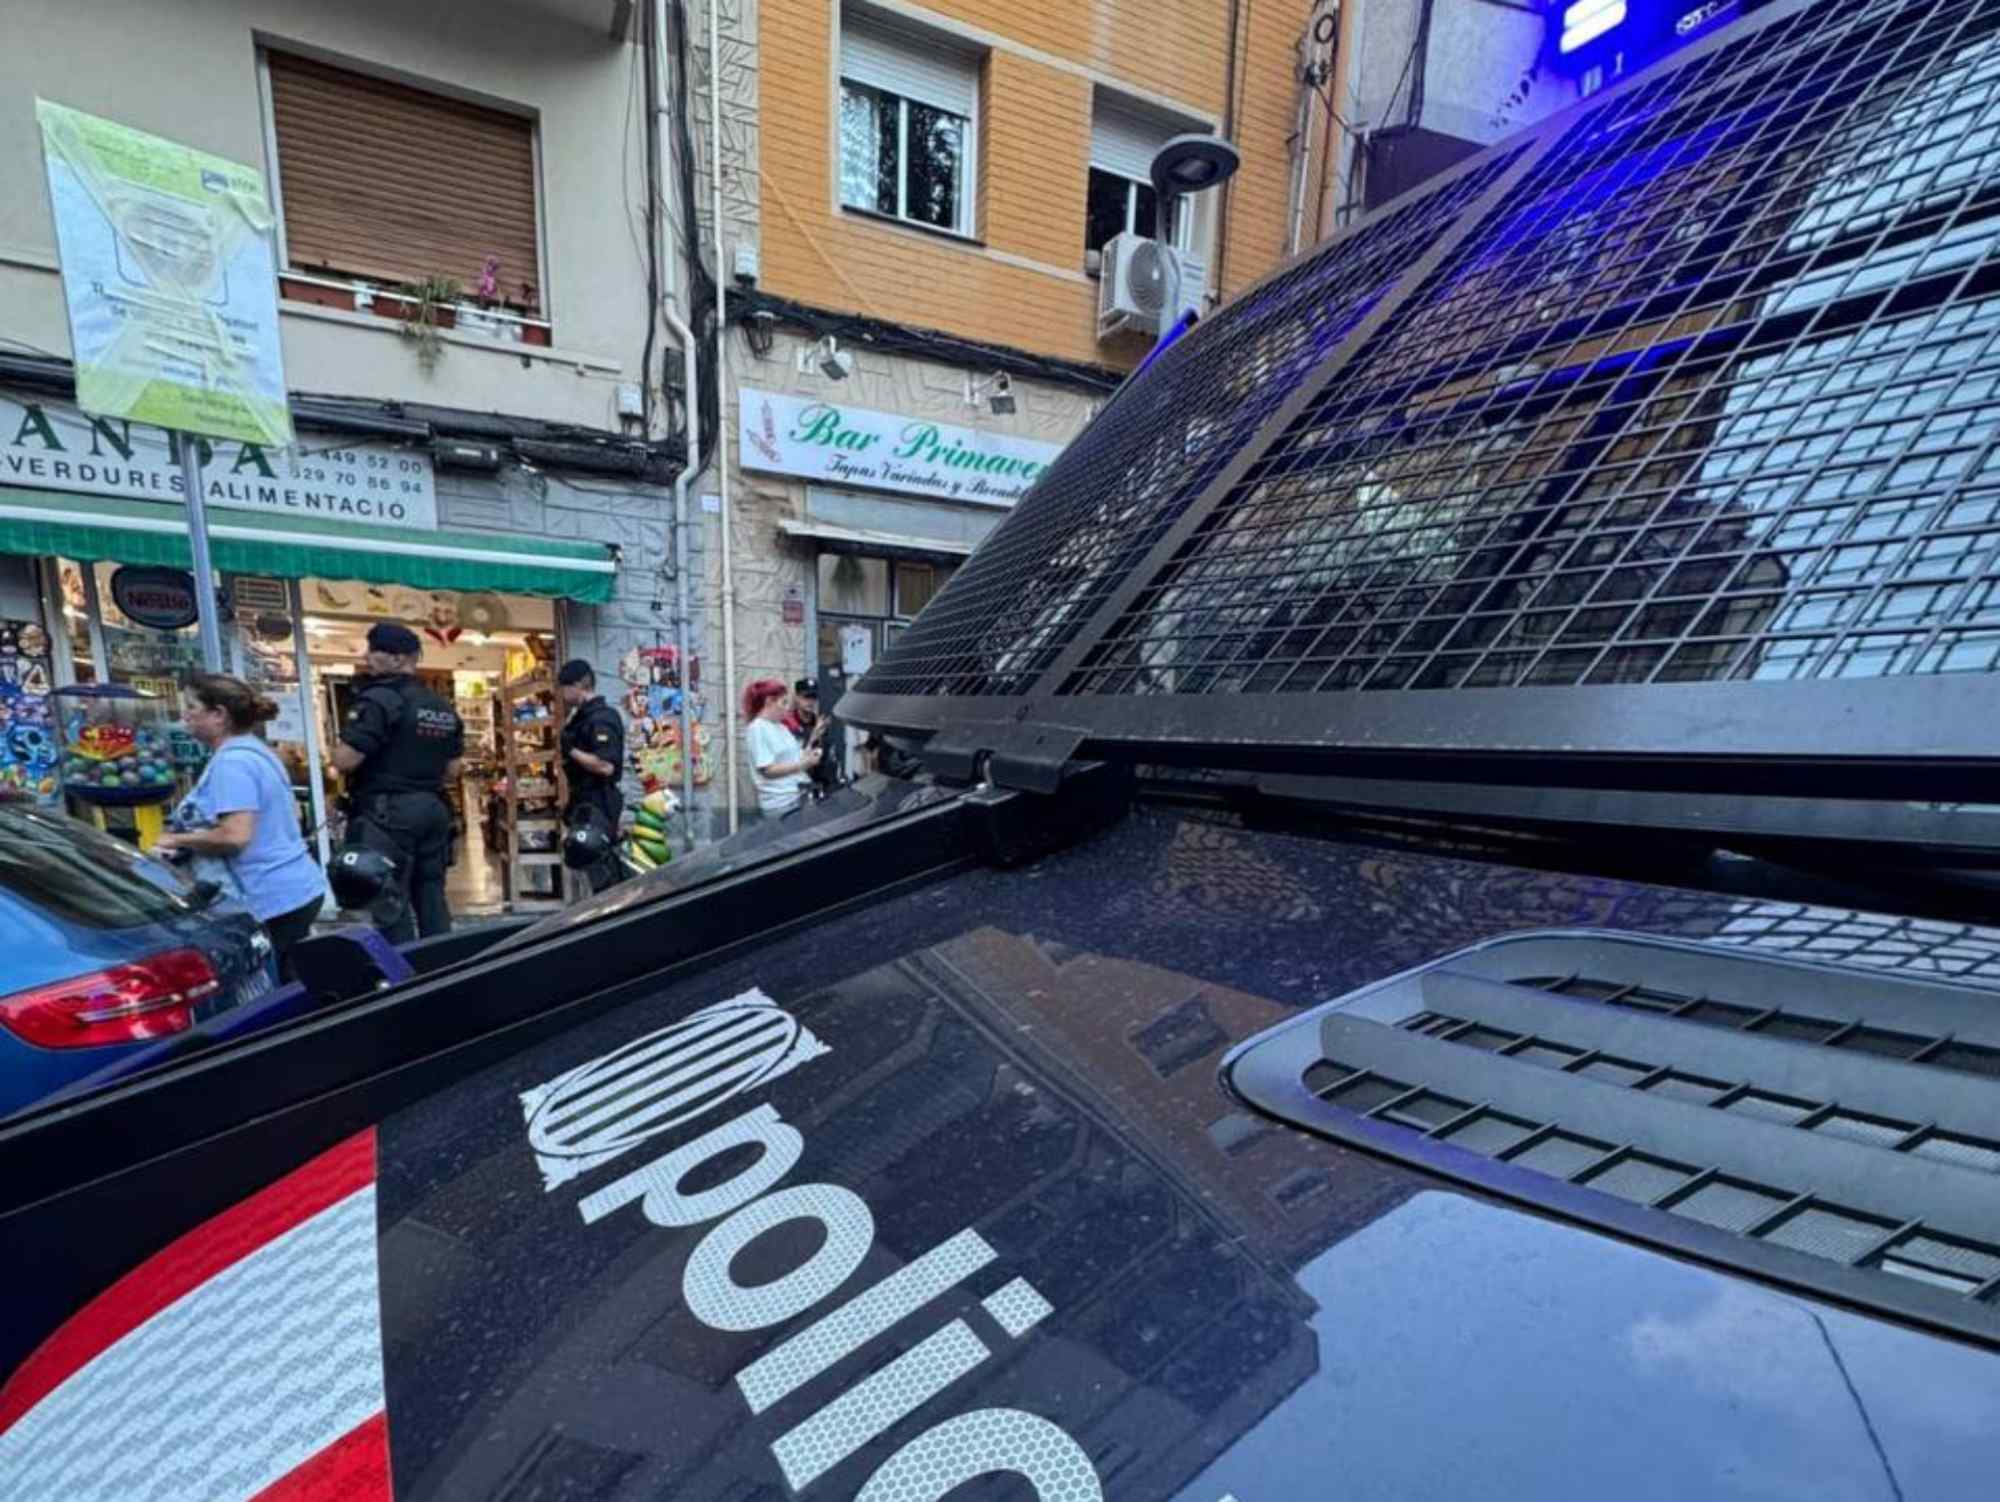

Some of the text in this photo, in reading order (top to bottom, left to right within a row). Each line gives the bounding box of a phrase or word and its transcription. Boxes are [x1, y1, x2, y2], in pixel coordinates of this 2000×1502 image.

[789, 402, 880, 451] Bar
[825, 453, 876, 478] Tapas
[335, 472, 356, 486] 70
